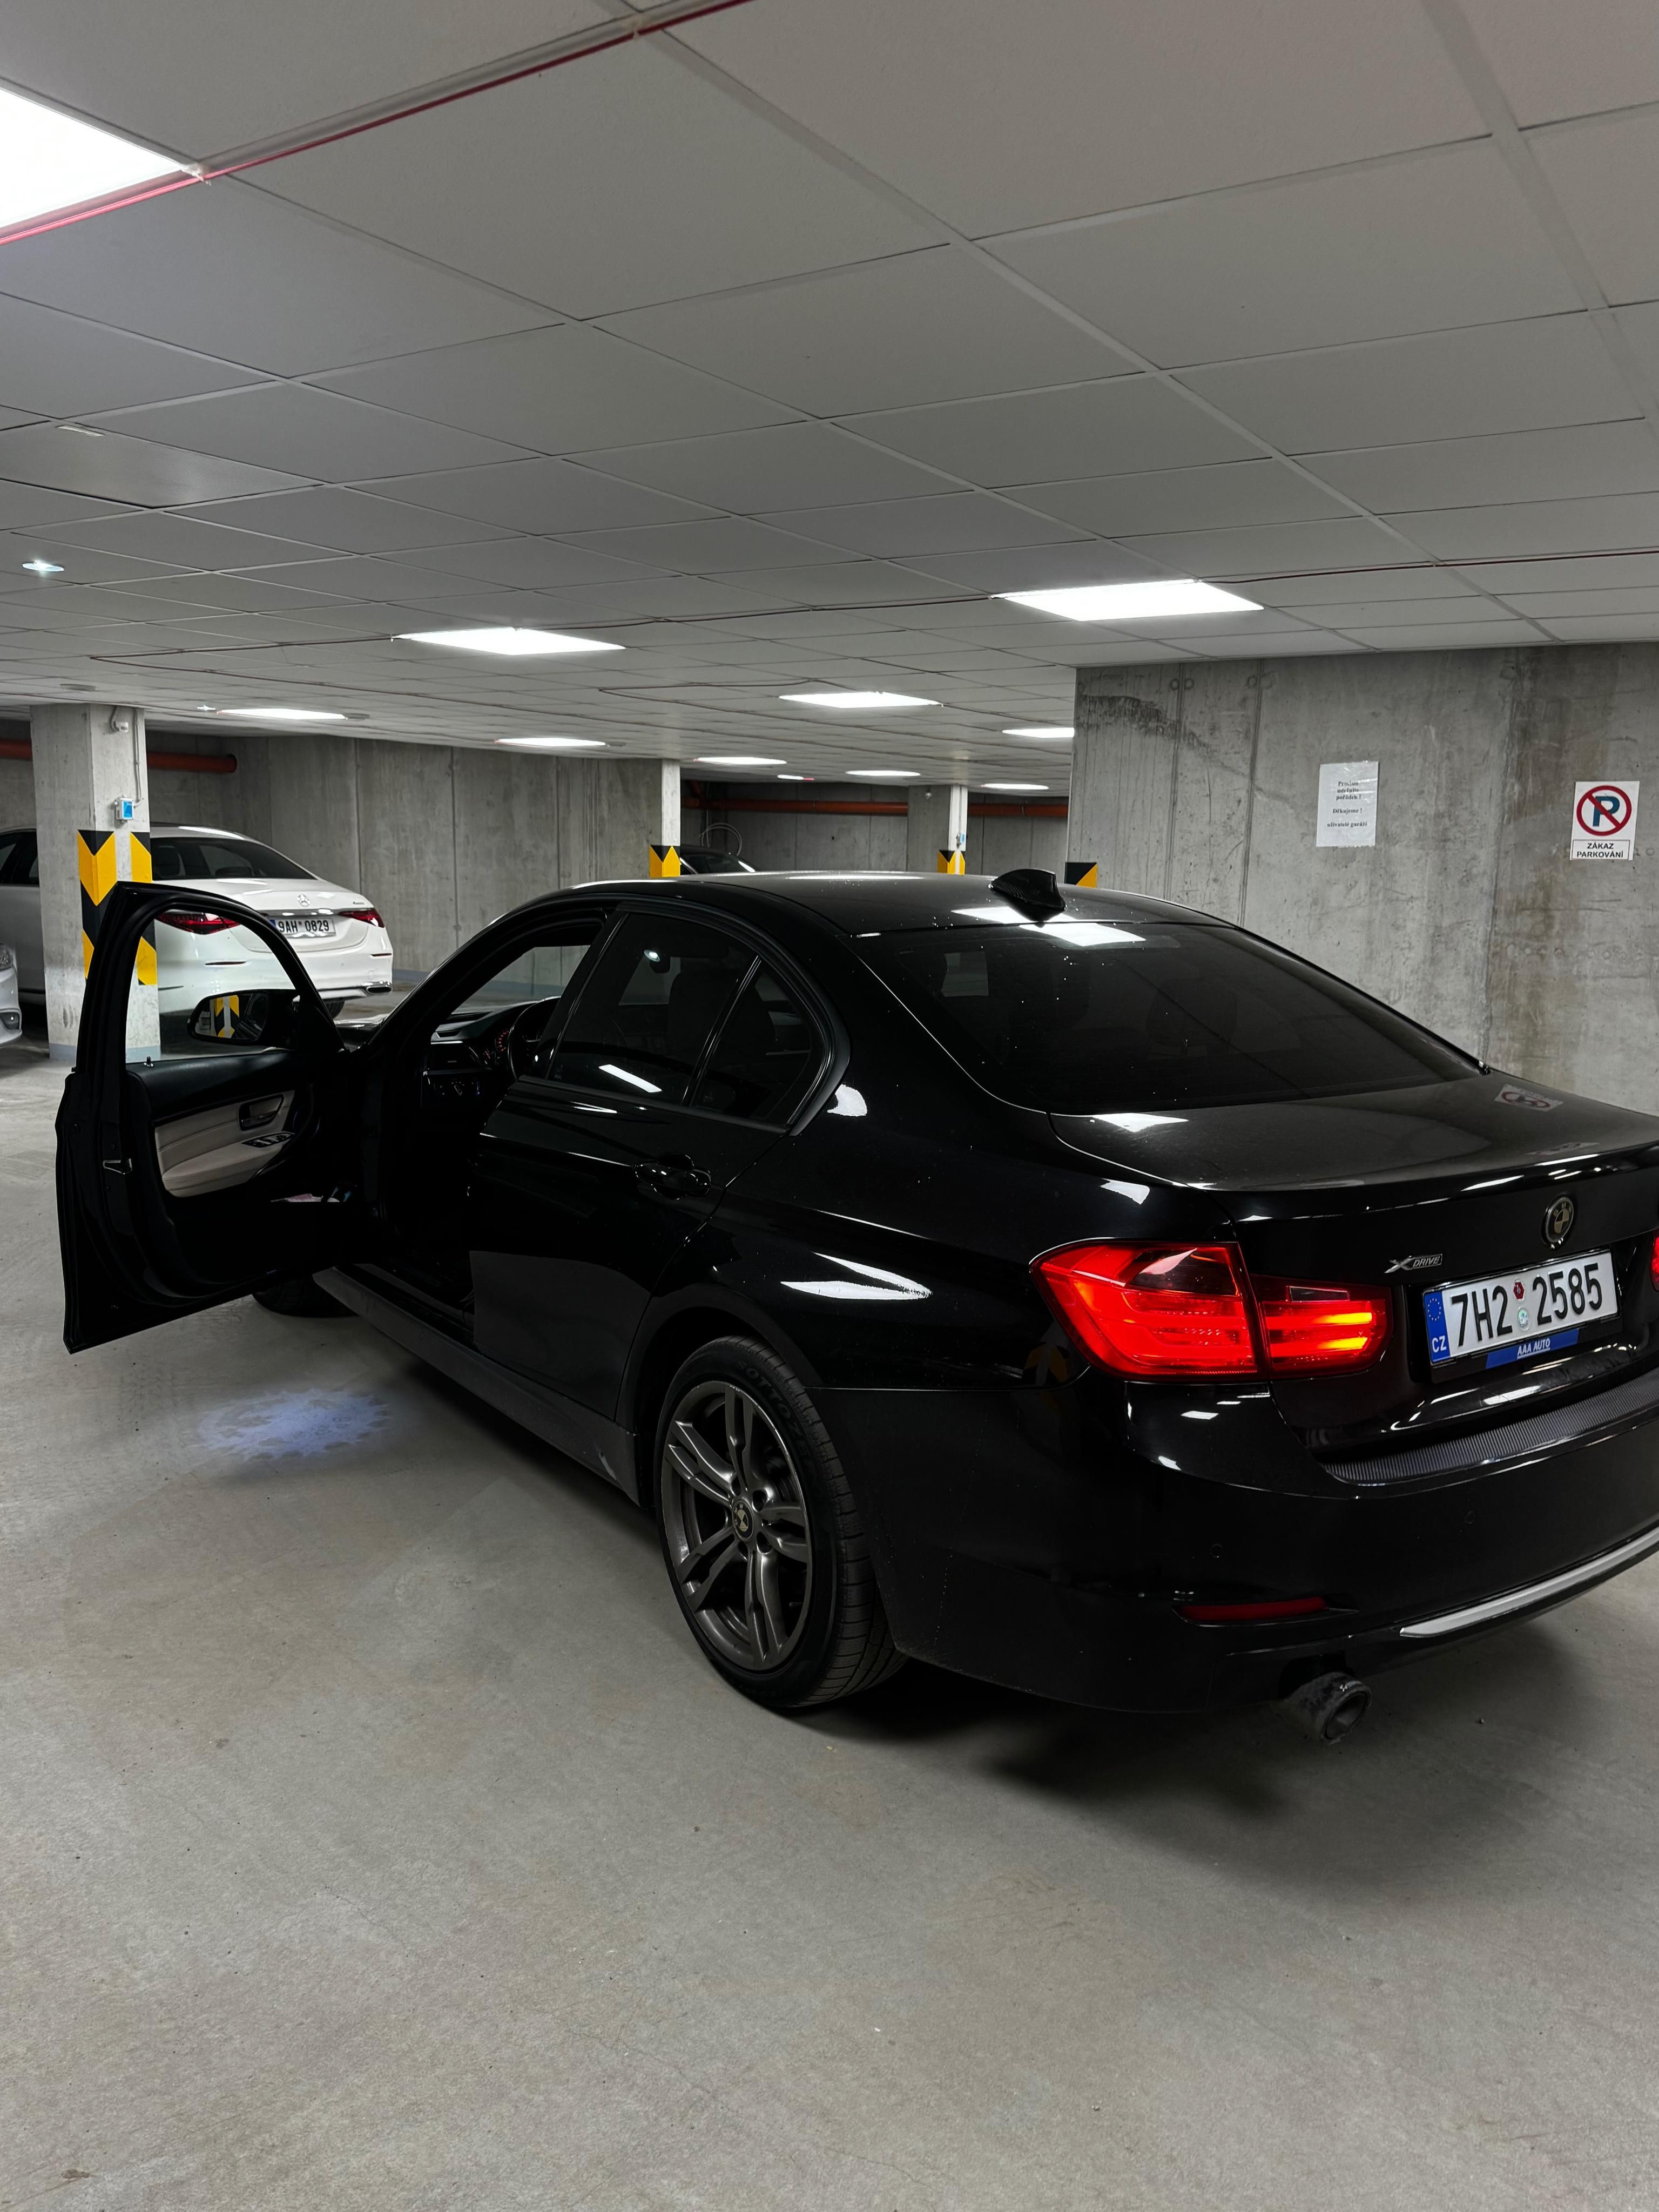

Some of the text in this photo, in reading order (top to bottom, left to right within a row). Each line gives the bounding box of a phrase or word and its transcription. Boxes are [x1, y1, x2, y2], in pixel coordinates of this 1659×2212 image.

[278, 920, 329, 932] 9AH 0829
[1451, 1263, 1603, 1347] 7H2 2585
[1432, 1336, 1447, 1353] CZ
[1517, 1338, 1550, 1357] AAA AUTO
